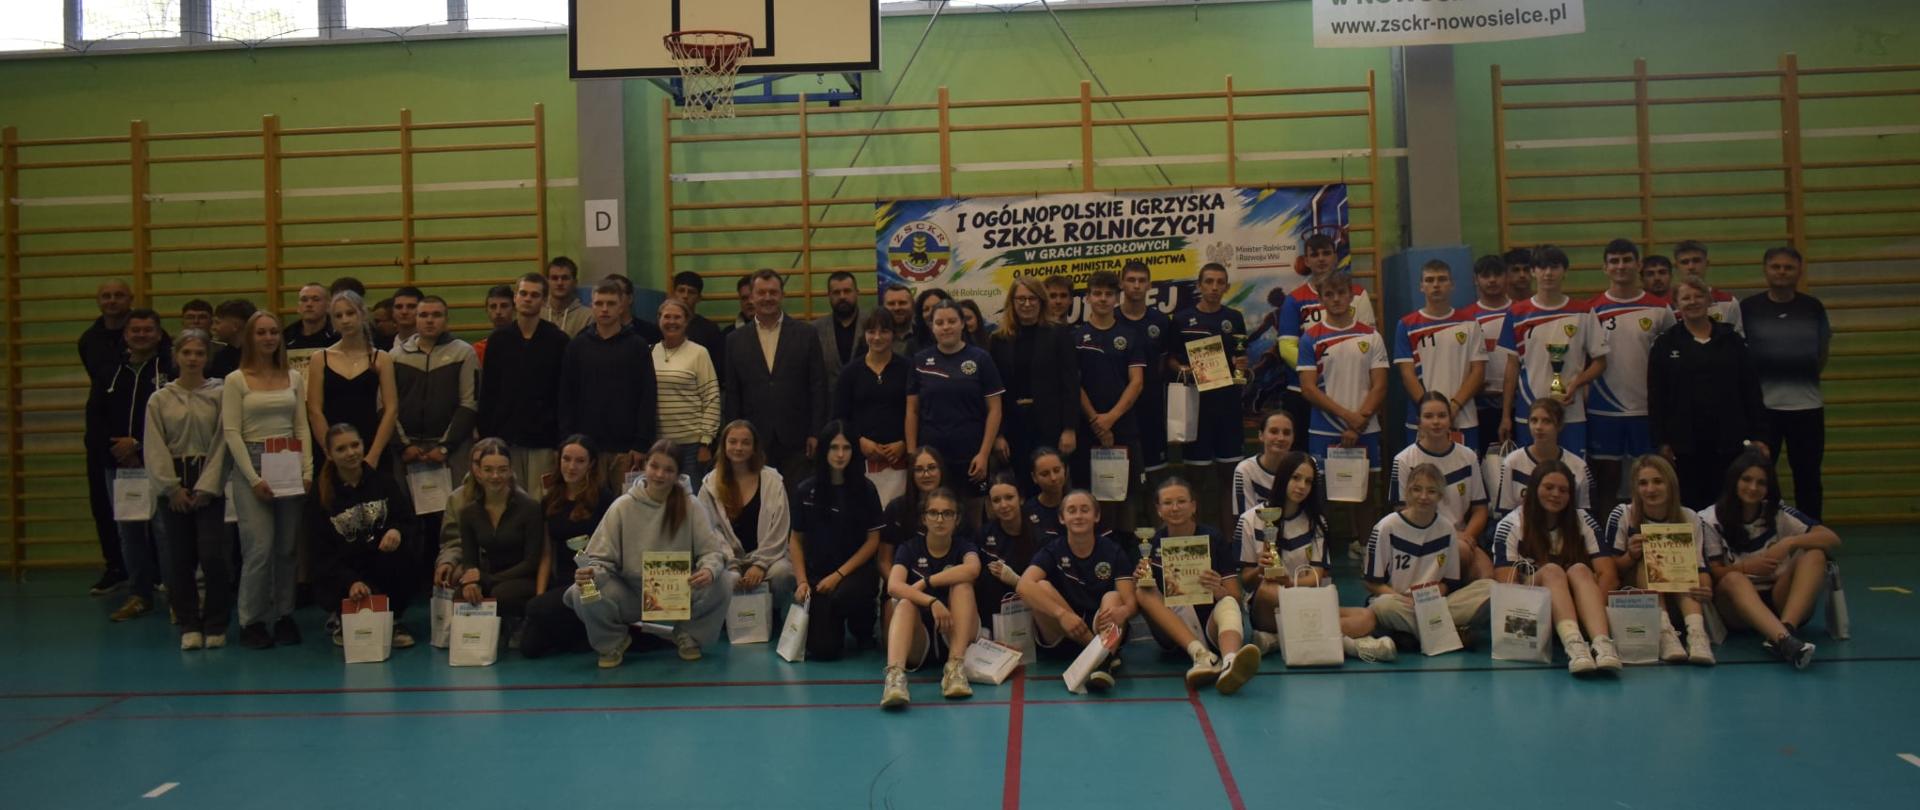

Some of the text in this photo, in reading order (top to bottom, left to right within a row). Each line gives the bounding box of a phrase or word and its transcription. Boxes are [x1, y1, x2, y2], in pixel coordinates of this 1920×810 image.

[1330, 3, 1567, 34] www.zsckr-nowosielce.pl
[596, 211, 611, 231] D
[956, 193, 1225, 233] I OGÓLNOPOLSKIE IGRZYSKA
[894, 223, 945, 243] ZSCKR
[983, 213, 1215, 249] SZKÓŁ ROLNICZYCH
[1024, 239, 1170, 262] W GRACH ZESPOŁOWYCH
[1013, 269, 1021, 279] O
[1024, 264, 1068, 277] PUCHAR
[1071, 259, 1122, 273] MINISTRA
[960, 287, 1002, 298] Rolniczych
[1301, 308, 1322, 322] 20
[1419, 332, 1435, 347] 11
[1395, 554, 1411, 570] 12
